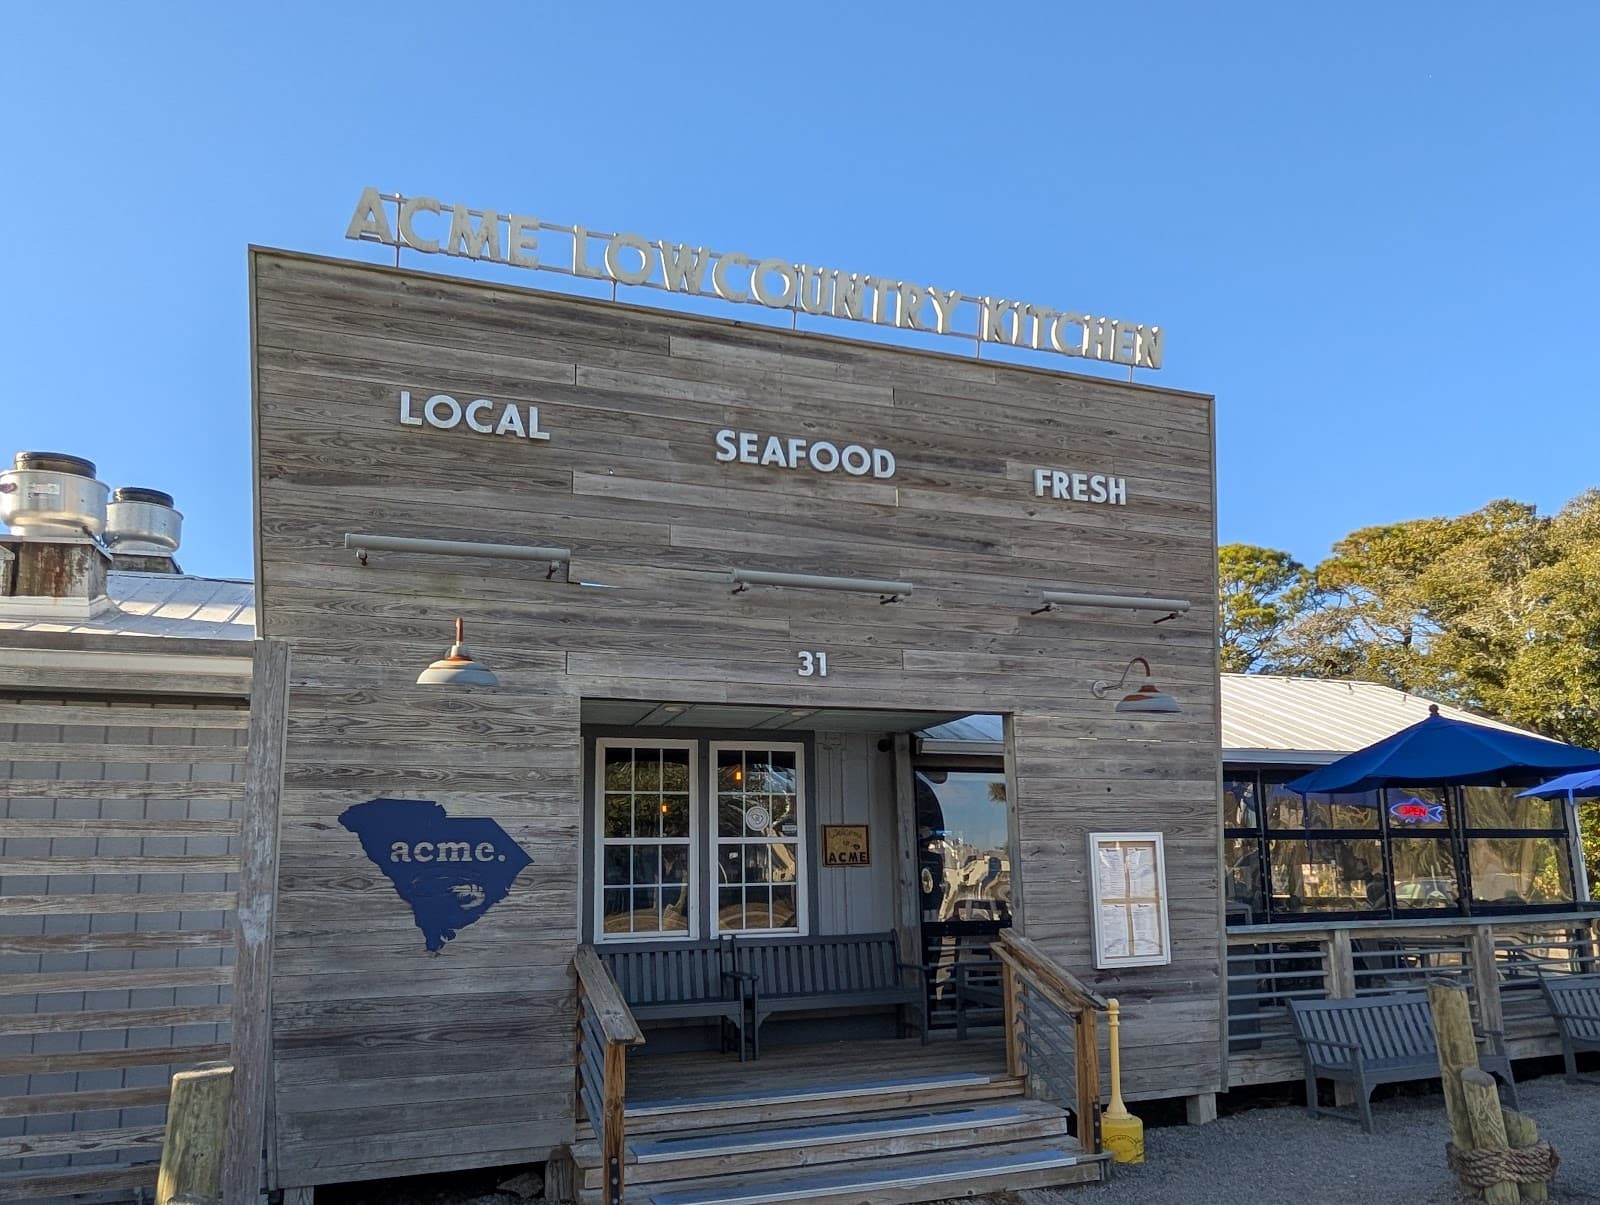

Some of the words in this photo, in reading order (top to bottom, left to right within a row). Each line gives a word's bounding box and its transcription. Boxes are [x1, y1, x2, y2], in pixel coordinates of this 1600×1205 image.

[345, 187, 540, 270] ACME
[572, 224, 961, 334] LOWCOUNTRY
[982, 295, 1164, 369] KITCHEN
[400, 391, 550, 440] LOCAL
[715, 429, 896, 479] SEAFOOD
[1034, 469, 1127, 505] FRESH
[798, 651, 827, 677] 31
[1400, 806, 1427, 817] OPEN
[390, 841, 506, 862] acme.
[830, 852, 866, 862] ACME
